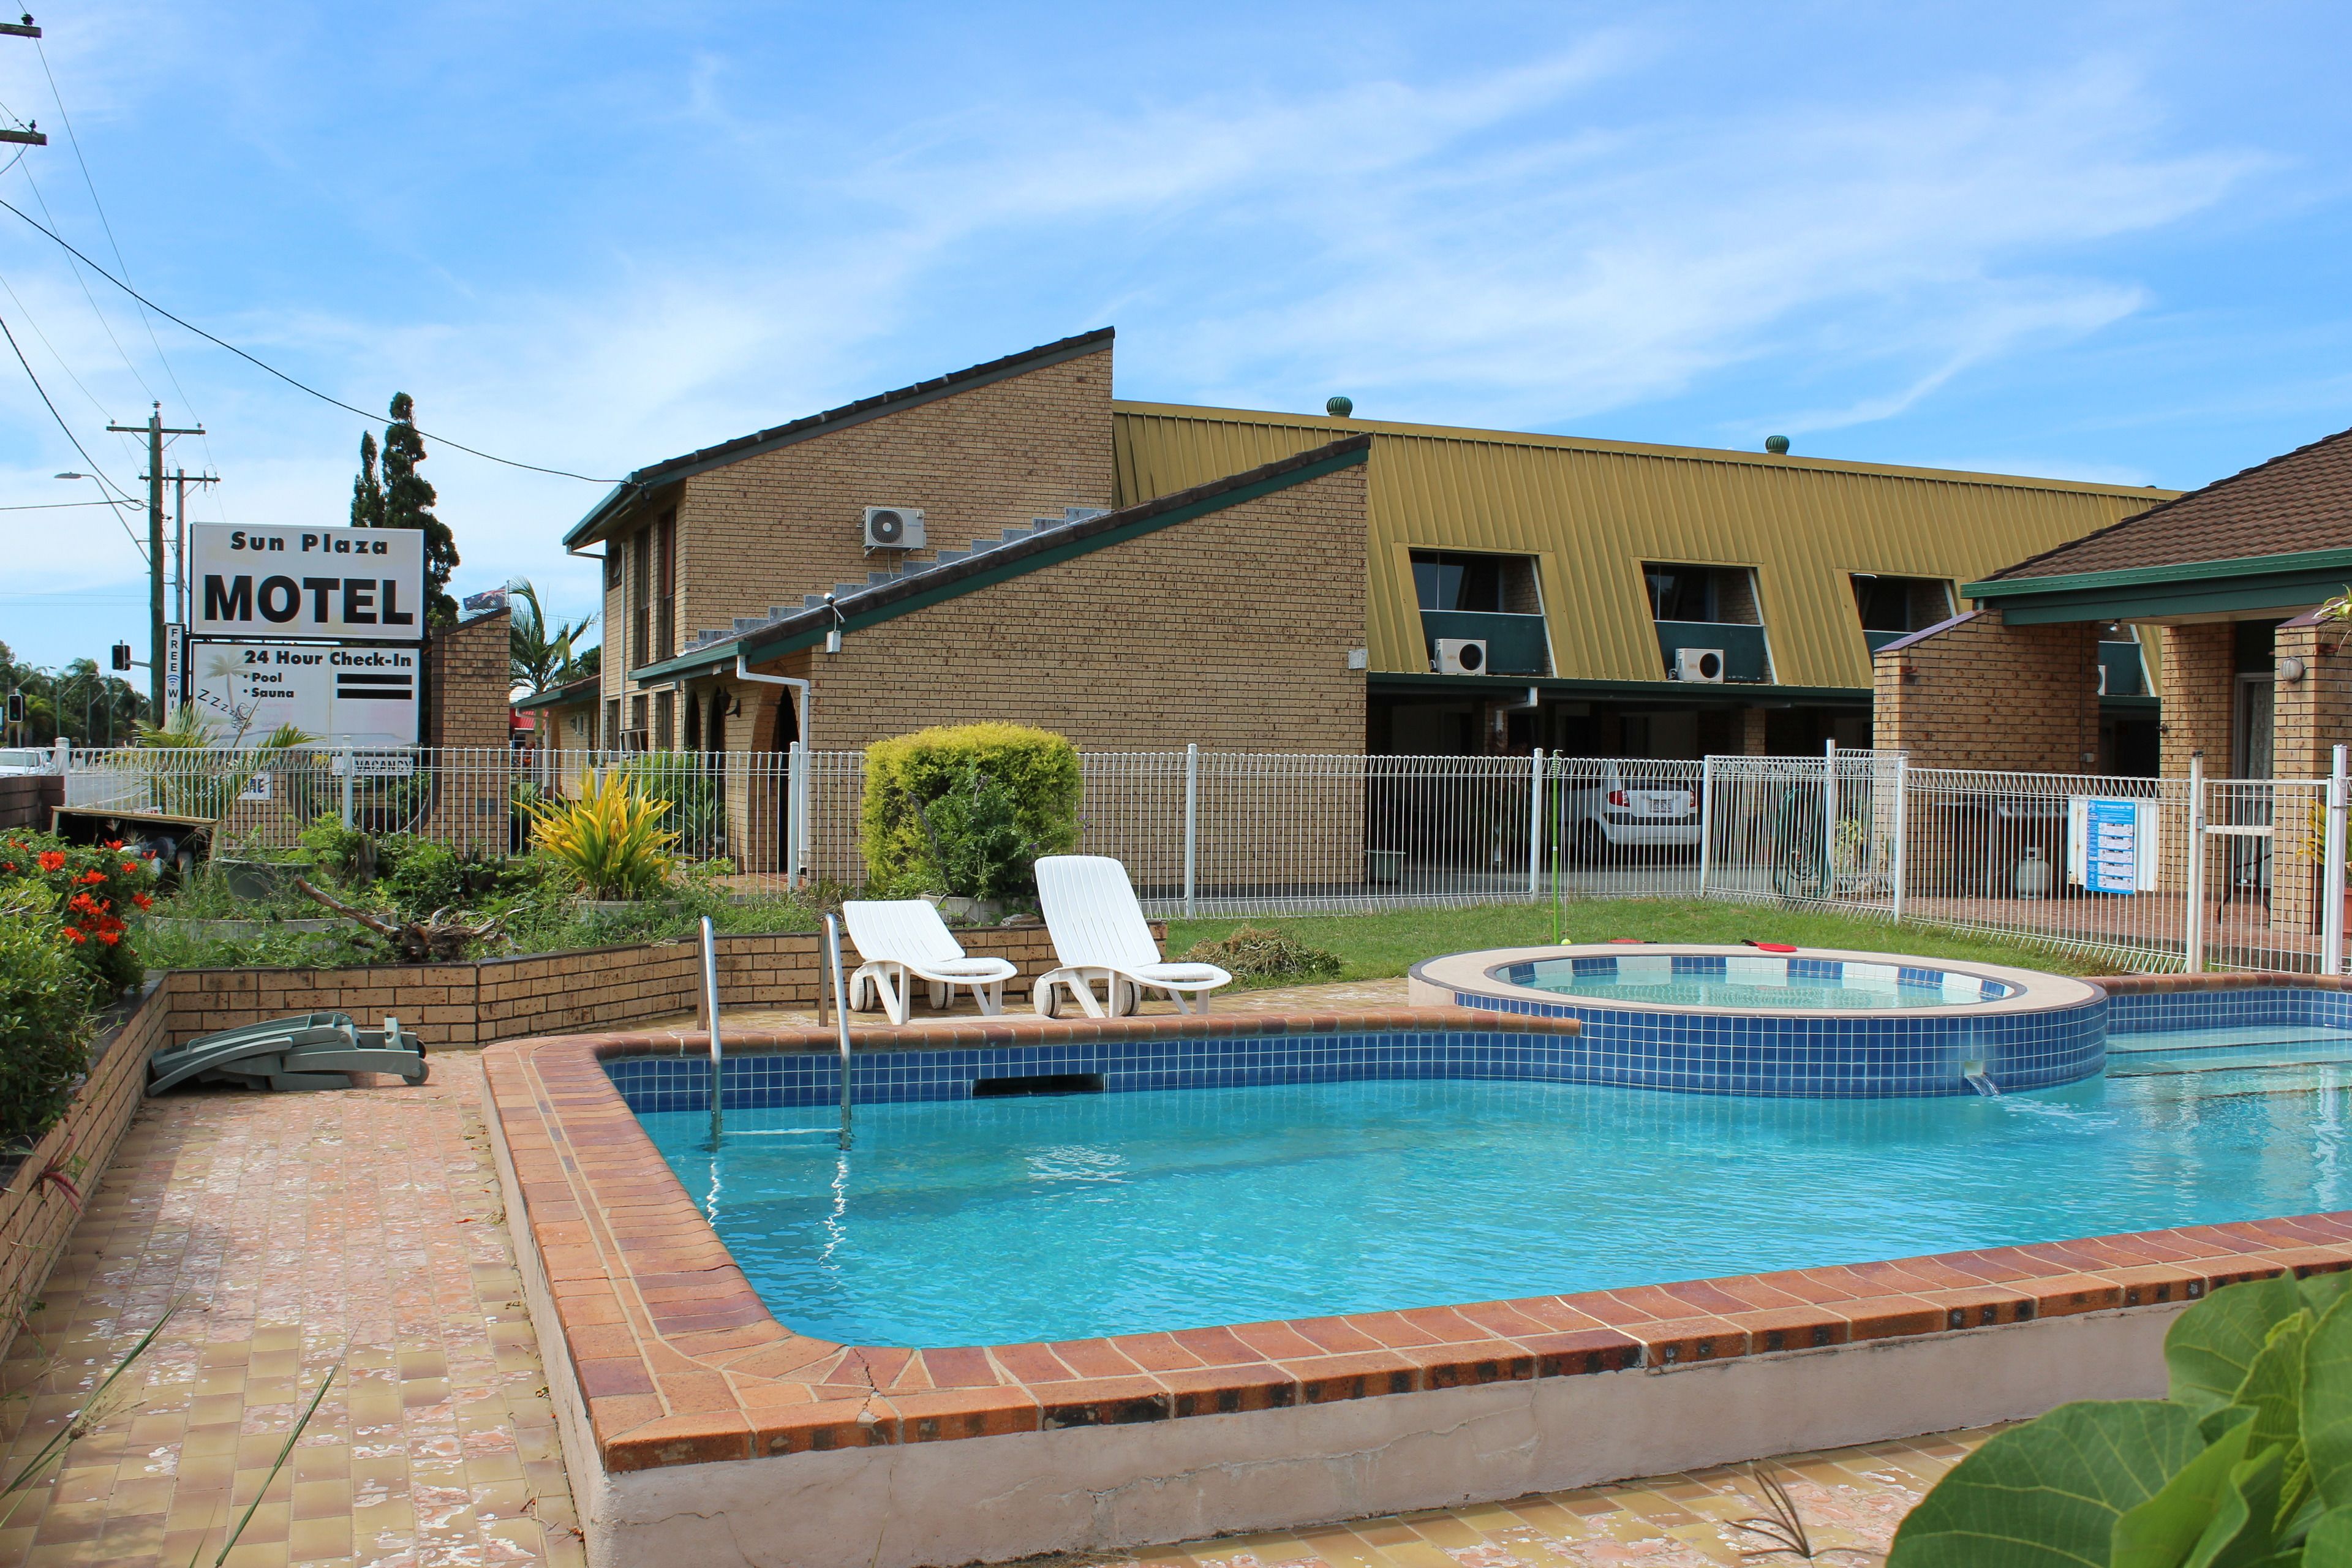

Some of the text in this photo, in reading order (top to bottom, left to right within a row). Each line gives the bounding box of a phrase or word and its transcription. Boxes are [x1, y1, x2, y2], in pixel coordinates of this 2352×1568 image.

[230, 531, 388, 555] Sun Plaza
[205, 575, 413, 625] MOTEL
[244, 650, 412, 667] 24 Hour Check-In
[252, 672, 282, 683] Pool
[251, 687, 295, 698] Sauna
[355, 760, 412, 772] VACANCY
